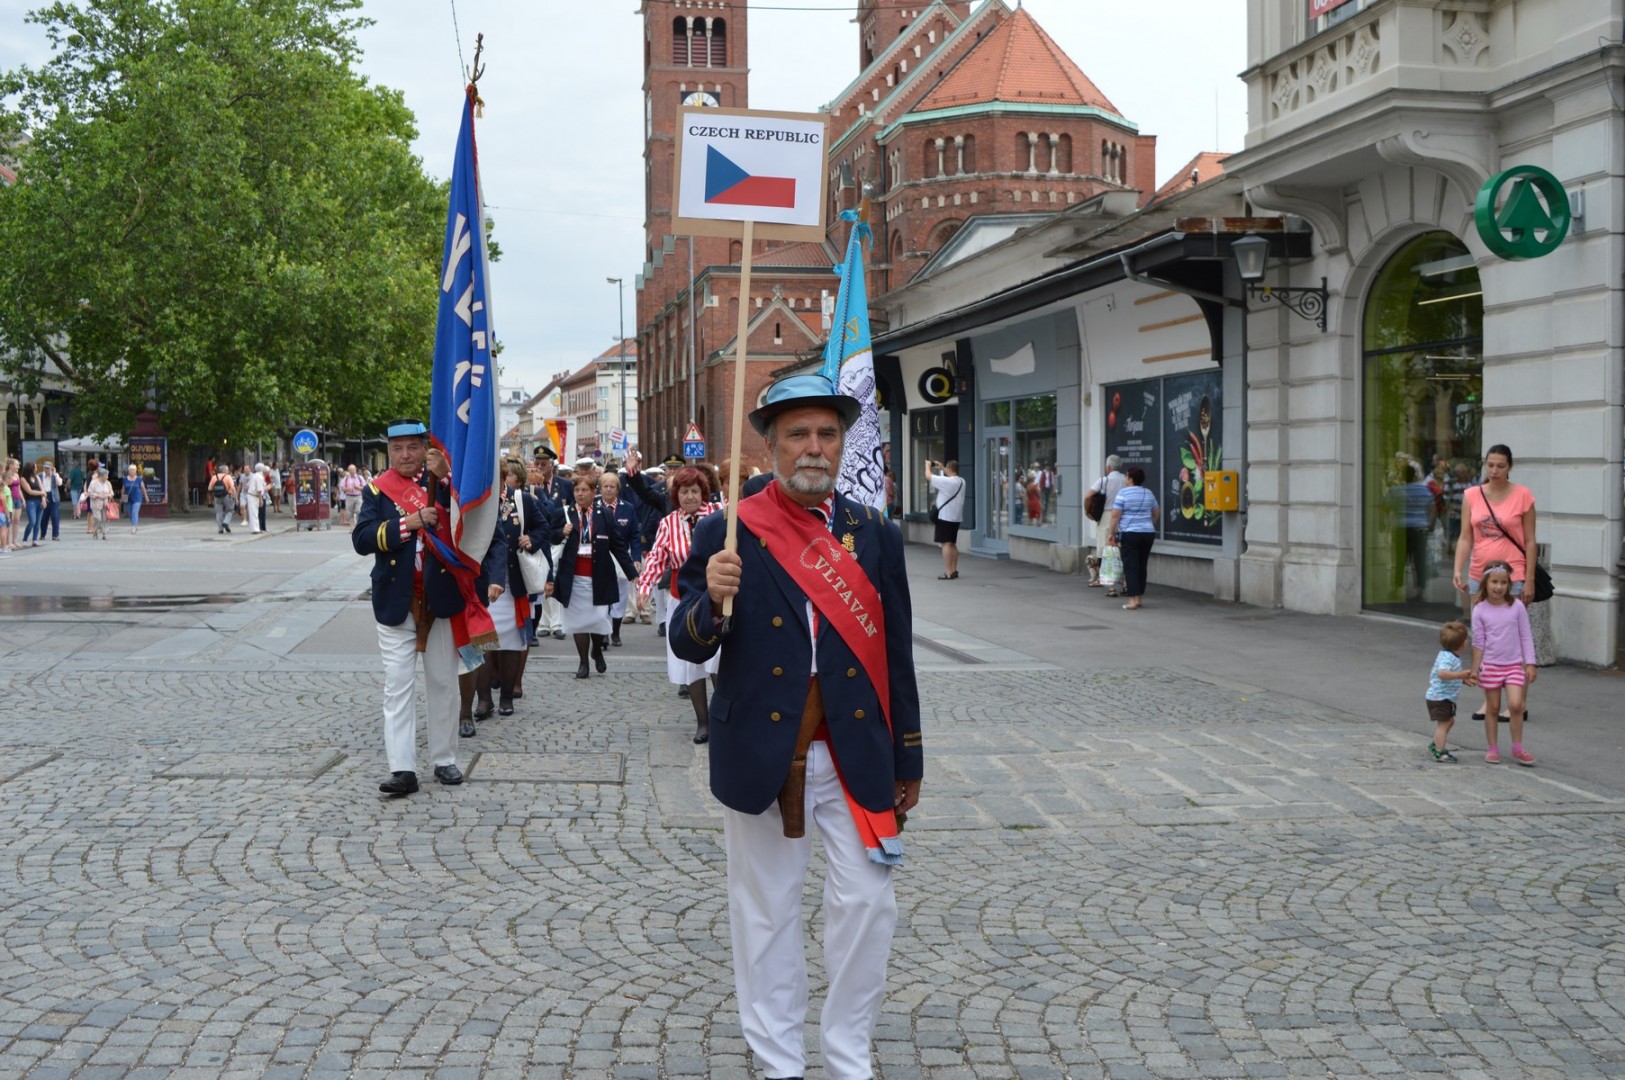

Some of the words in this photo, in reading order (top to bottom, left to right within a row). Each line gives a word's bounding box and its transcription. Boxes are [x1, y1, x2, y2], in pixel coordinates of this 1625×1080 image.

[689, 126, 739, 139] CZECH
[745, 129, 820, 144] REPUBLIC
[814, 554, 878, 638] VLTAVAN
